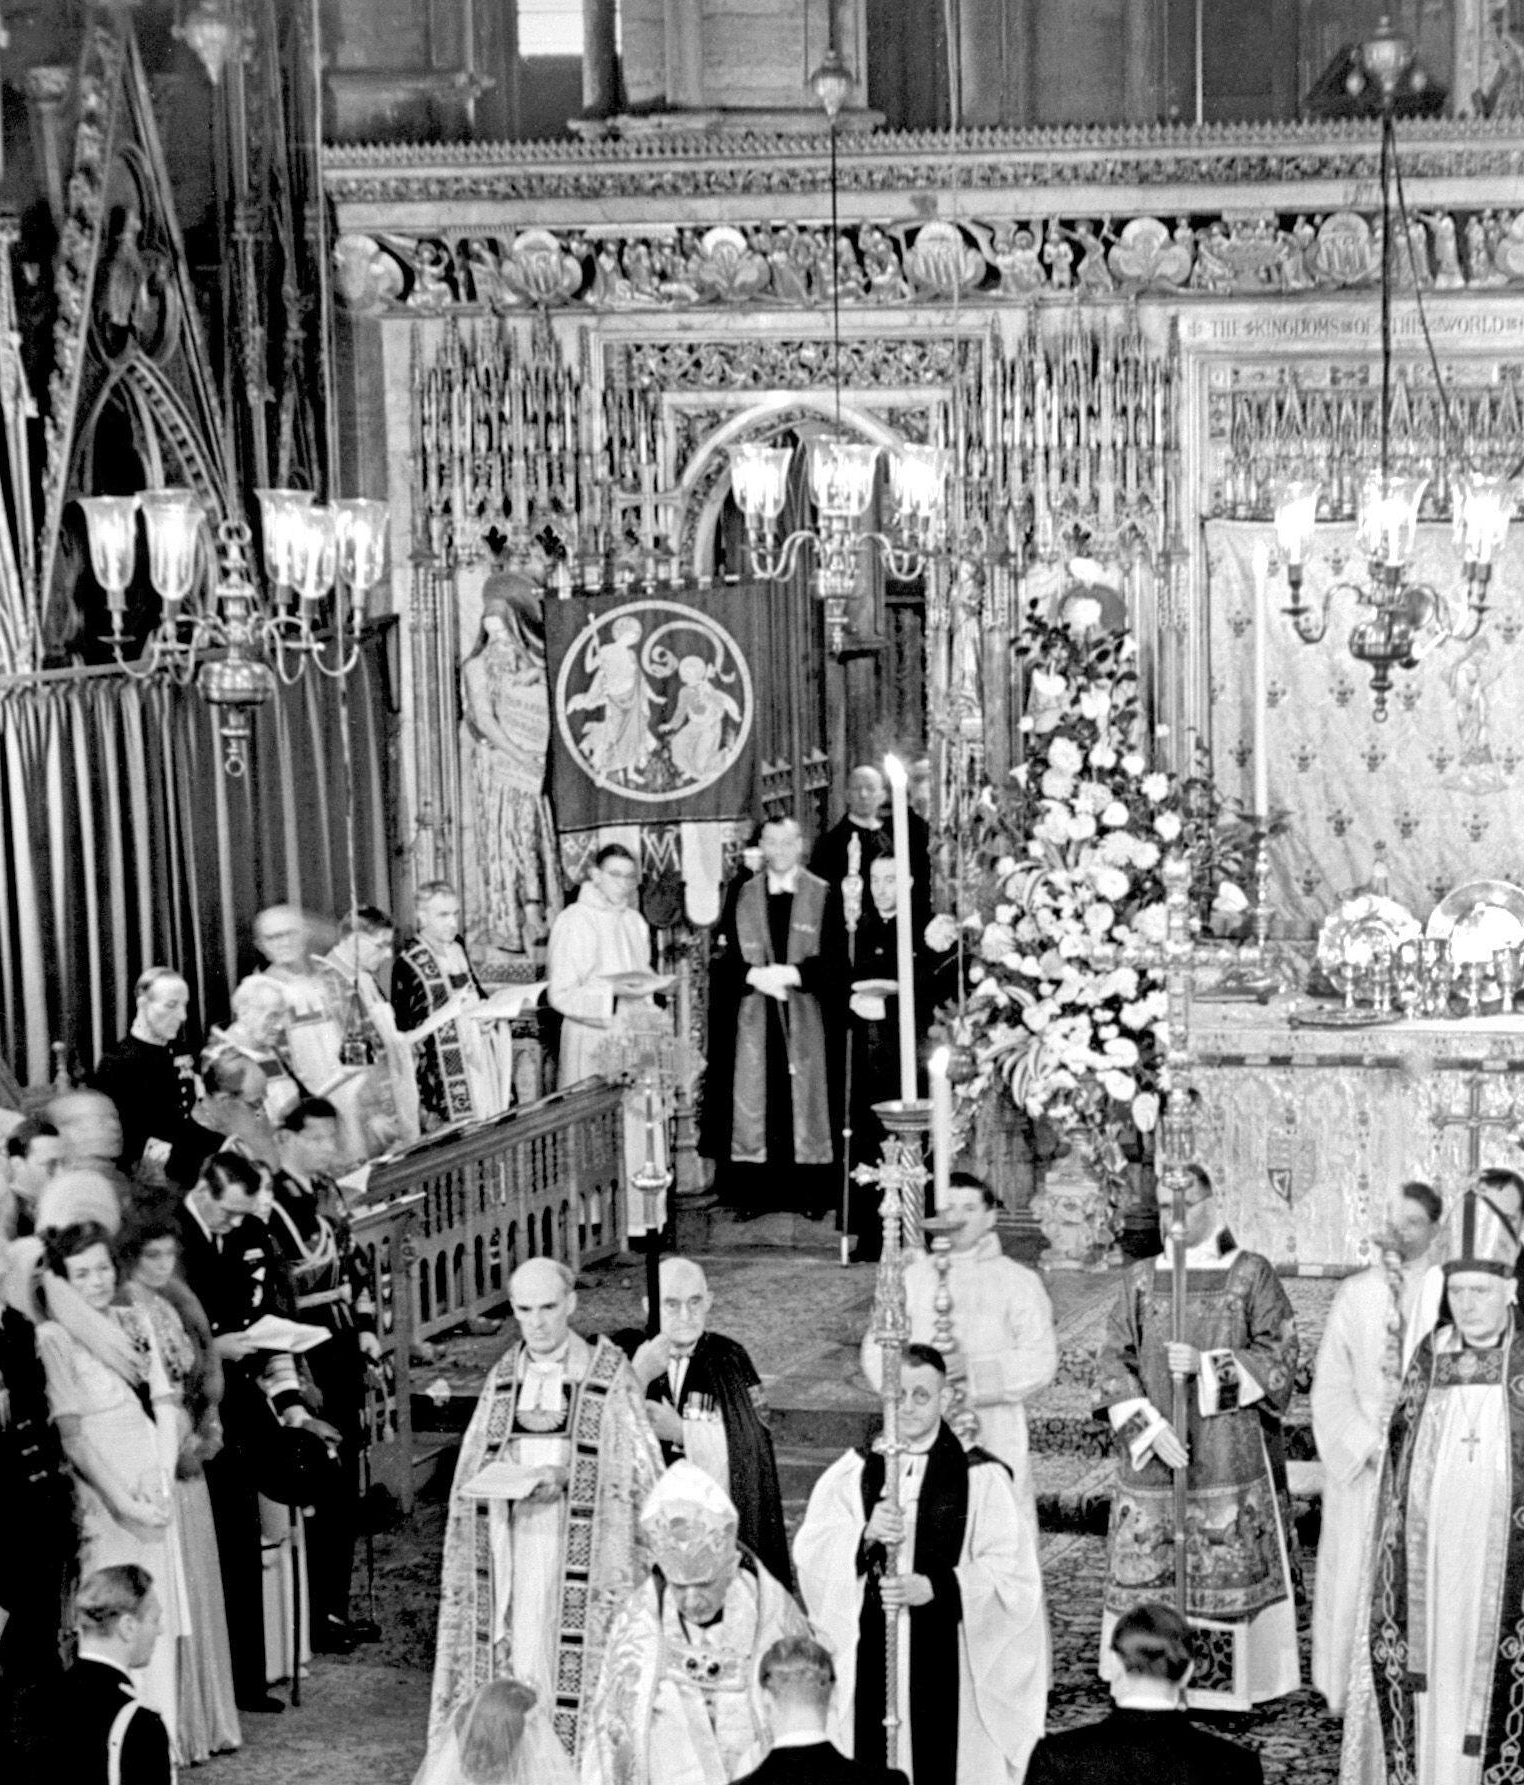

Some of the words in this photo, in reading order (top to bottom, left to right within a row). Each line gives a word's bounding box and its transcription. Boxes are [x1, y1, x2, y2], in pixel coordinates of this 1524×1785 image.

[1255, 317, 1338, 338] KINGDOMS
[1354, 316, 1371, 336] OF
[1438, 315, 1504, 334] WORLD
